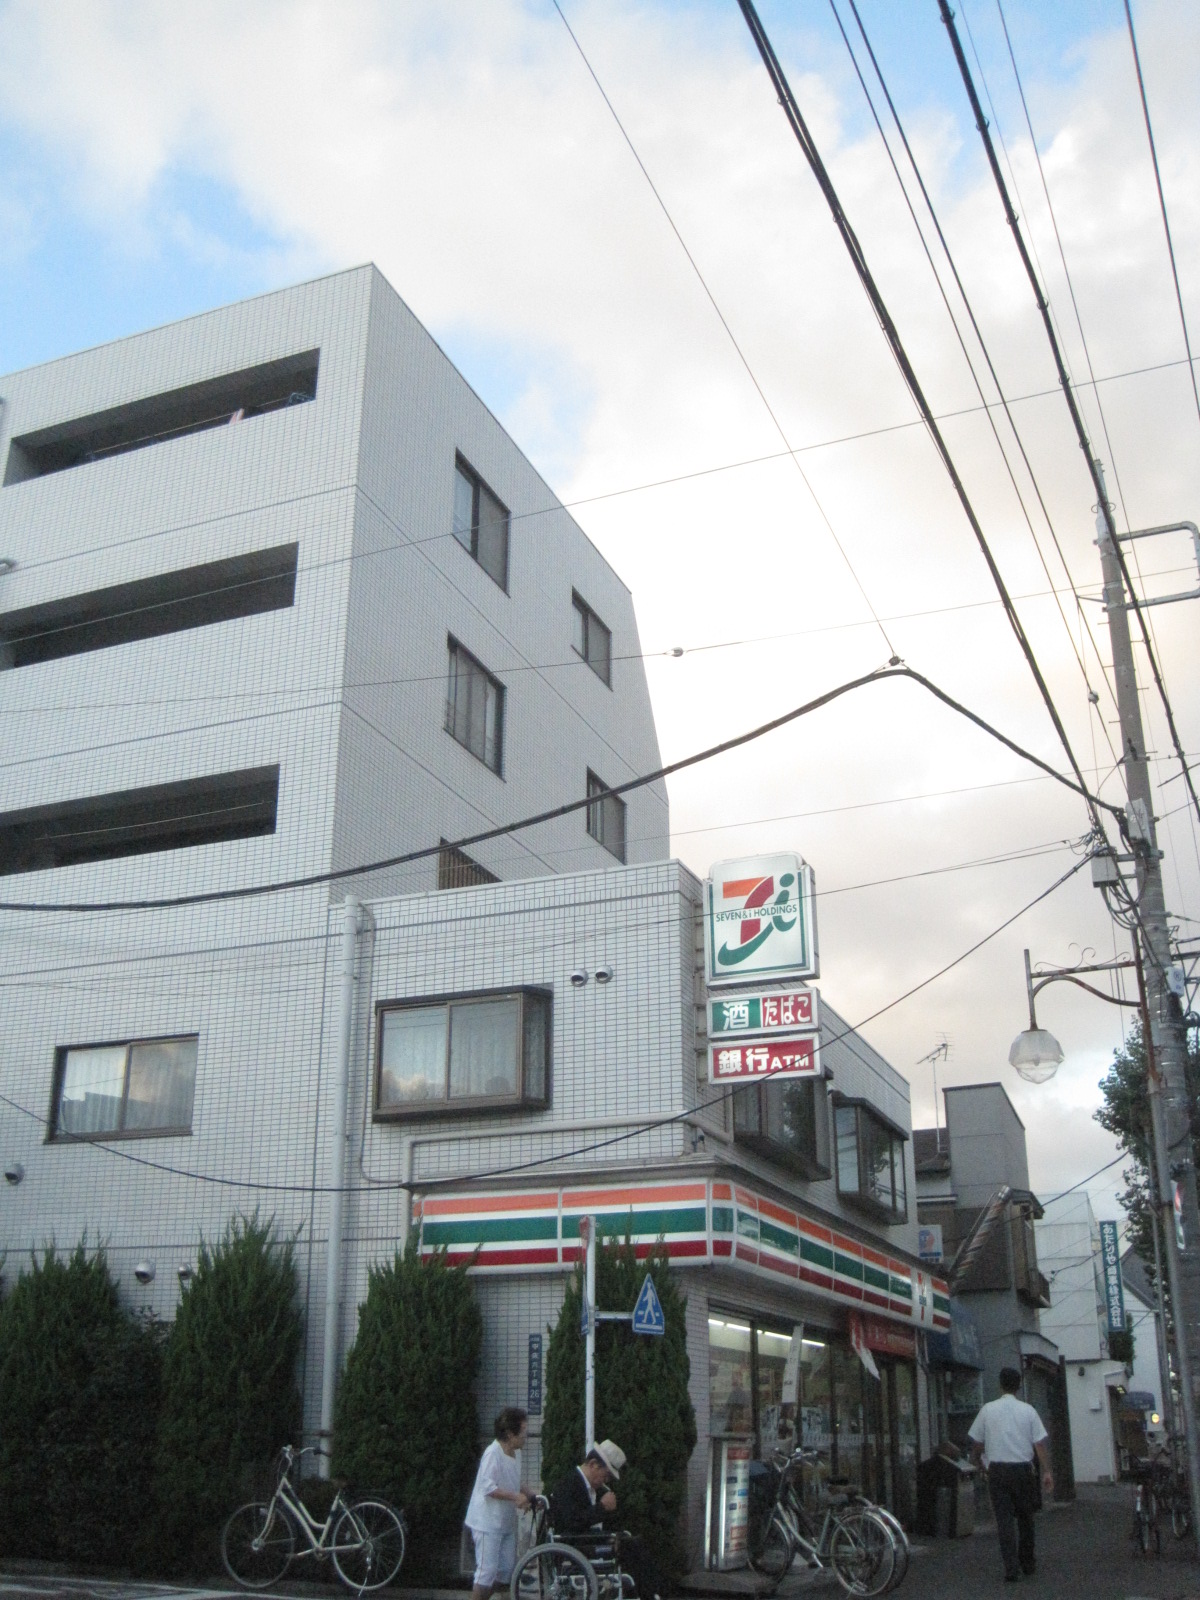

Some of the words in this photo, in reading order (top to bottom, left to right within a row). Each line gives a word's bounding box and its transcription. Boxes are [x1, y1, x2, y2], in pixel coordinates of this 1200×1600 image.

[754, 904, 798, 917] HOLDINGS
[723, 1001, 749, 1031] 酒
[764, 996, 811, 1027] たばこ
